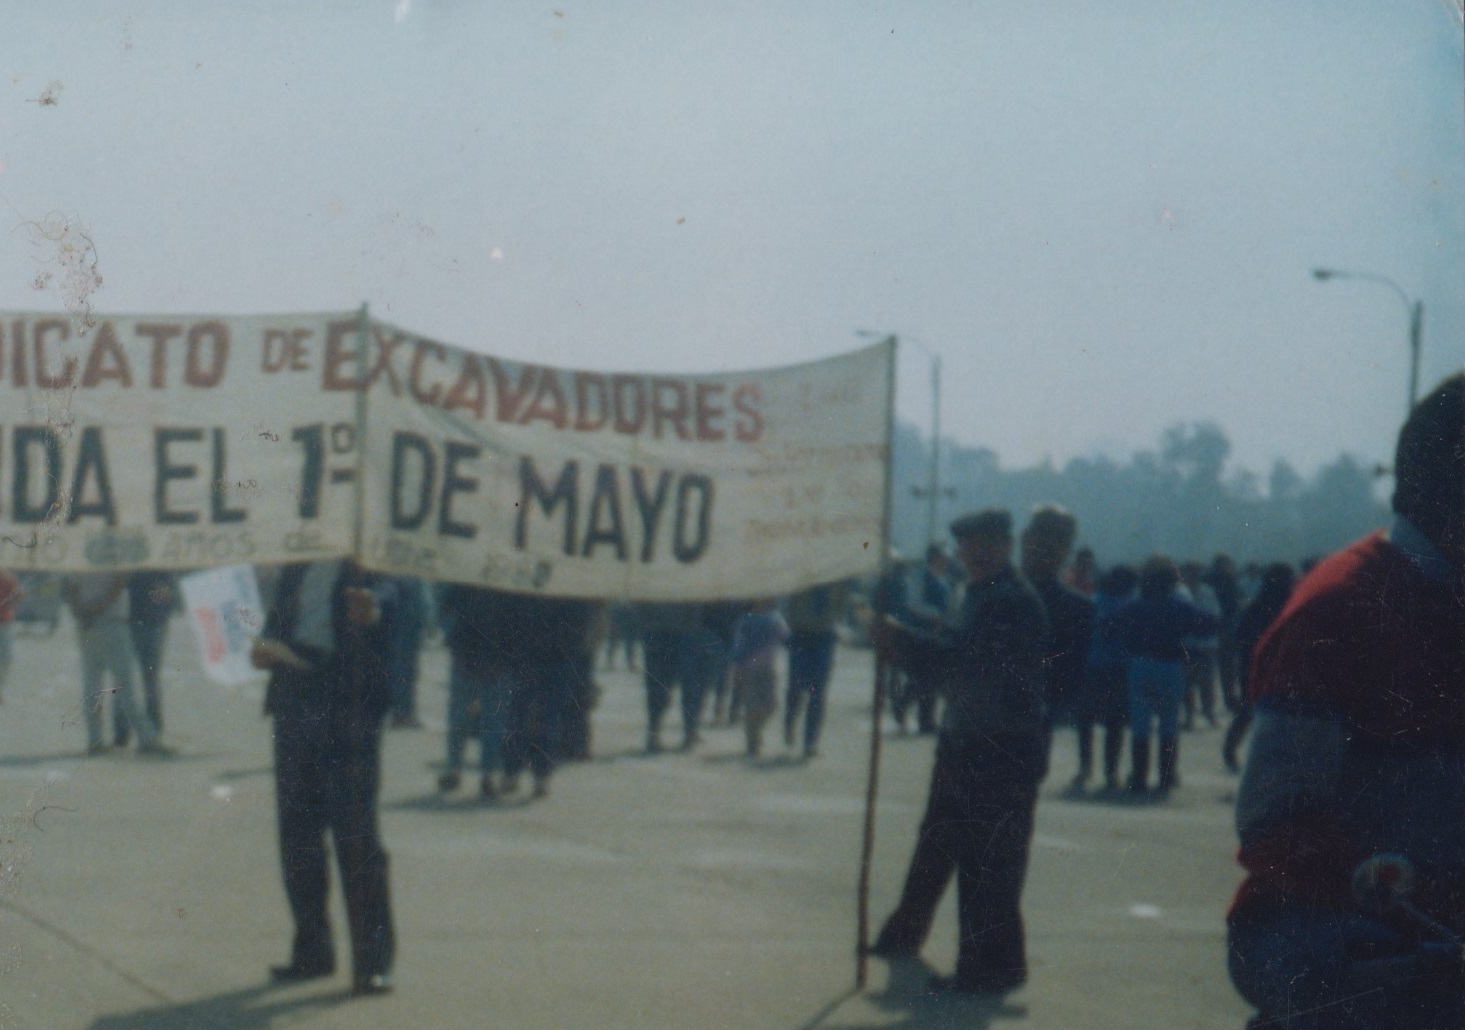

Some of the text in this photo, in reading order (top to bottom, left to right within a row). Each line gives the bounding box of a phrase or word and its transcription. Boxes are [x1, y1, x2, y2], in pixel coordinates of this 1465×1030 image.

[262, 327, 314, 373] DE
[323, 320, 765, 443] EXCAVADORES
[153, 426, 247, 525] EL
[391, 430, 479, 539] DE
[515, 455, 713, 563] MAYO
